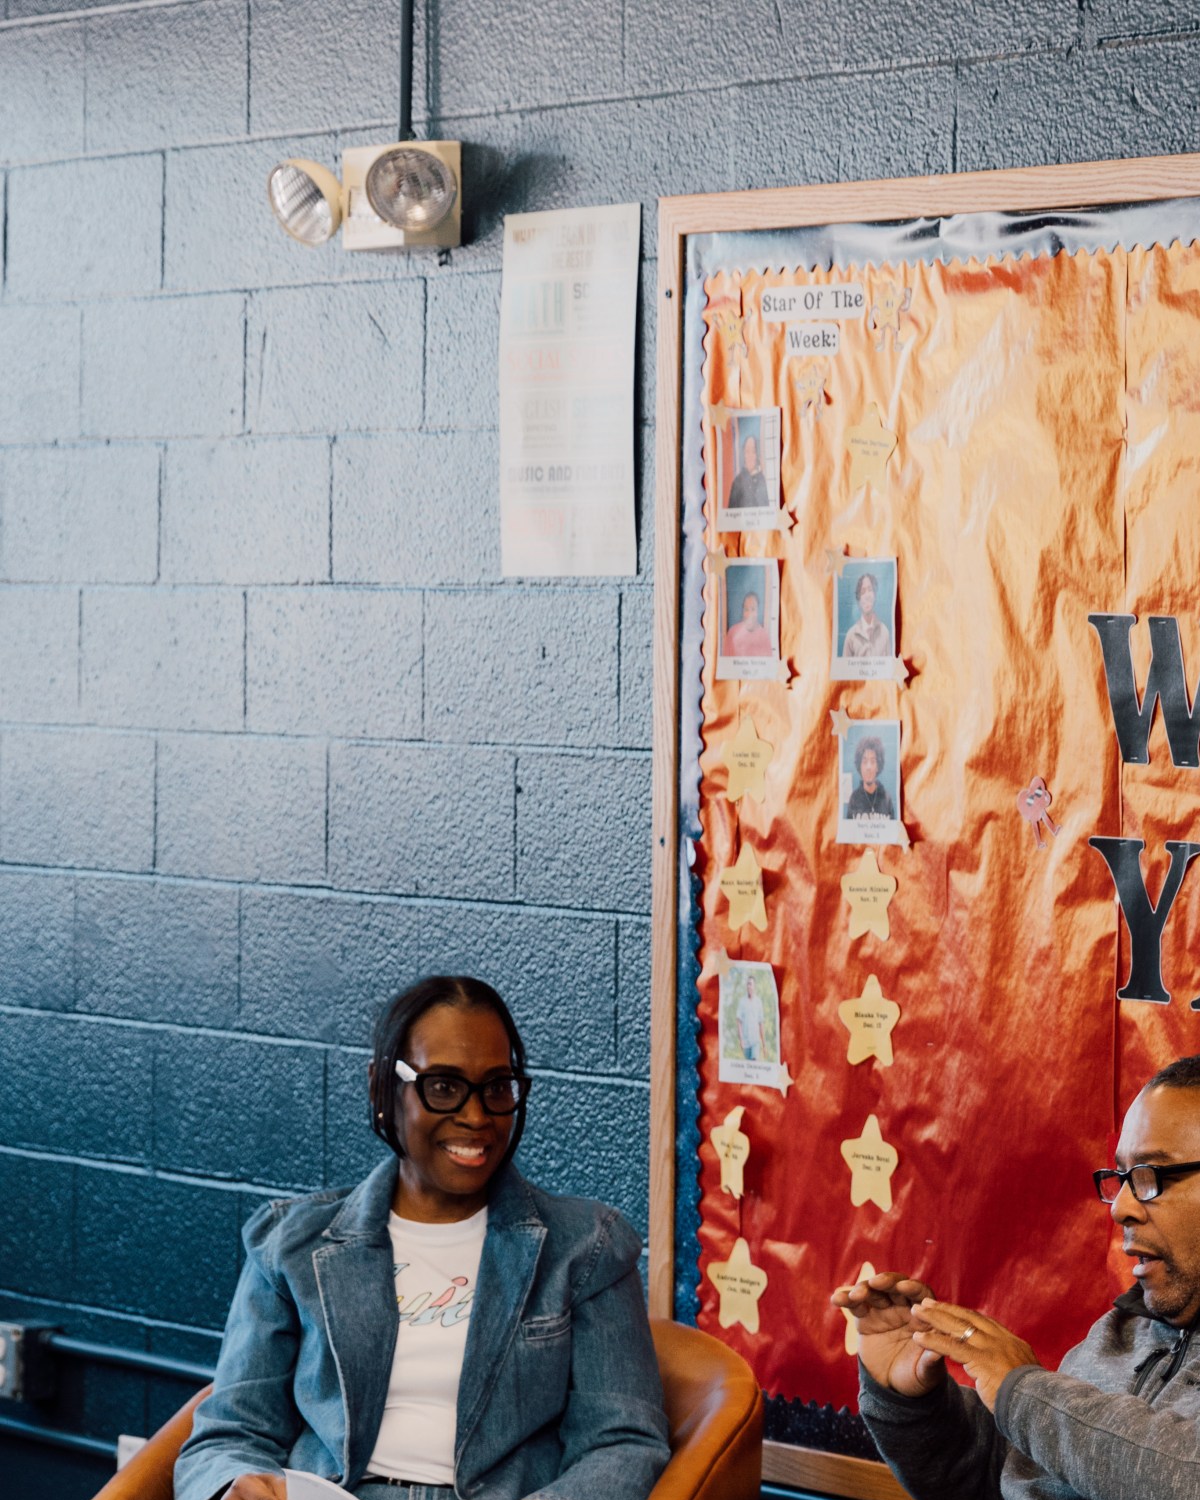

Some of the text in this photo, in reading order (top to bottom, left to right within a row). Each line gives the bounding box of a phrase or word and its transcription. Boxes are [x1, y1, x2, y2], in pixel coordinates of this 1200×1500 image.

[762, 289, 864, 312] Star Of The
[789, 328, 837, 349] Week:
[548, 464, 572, 481] AND
